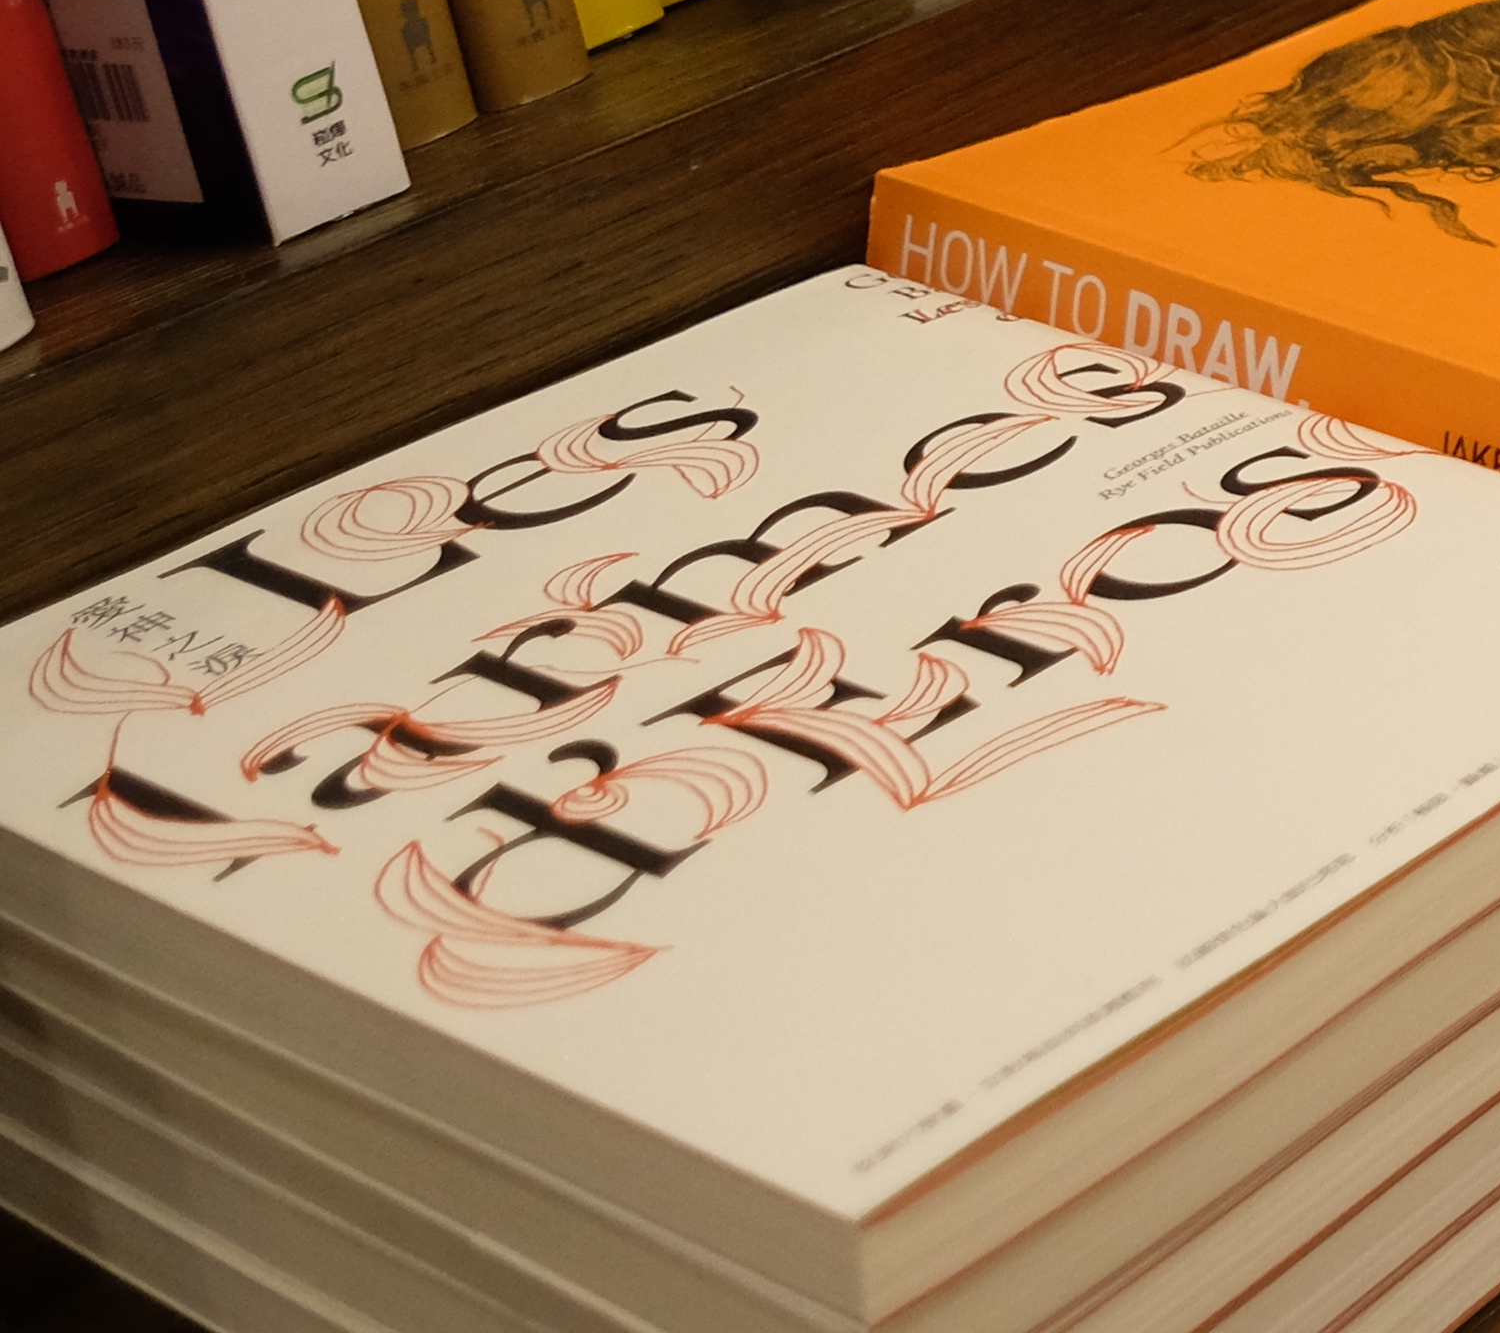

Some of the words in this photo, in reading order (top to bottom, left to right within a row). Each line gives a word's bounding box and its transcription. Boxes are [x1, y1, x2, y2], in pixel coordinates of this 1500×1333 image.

[318, 141, 354, 168] 文化
[898, 213, 1030, 323] HOW
[1041, 255, 1108, 343] TO
[1121, 286, 1313, 411] DRAW.
[156, 388, 762, 620] Les
[1098, 478, 1133, 504] Rye
[1134, 455, 1190, 493] Field
[1184, 405, 1294, 468] Publications
[1101, 440, 1164, 484] Georges
[1158, 408, 1252, 451] Bataille
[58, 361, 1188, 884] Larmes
